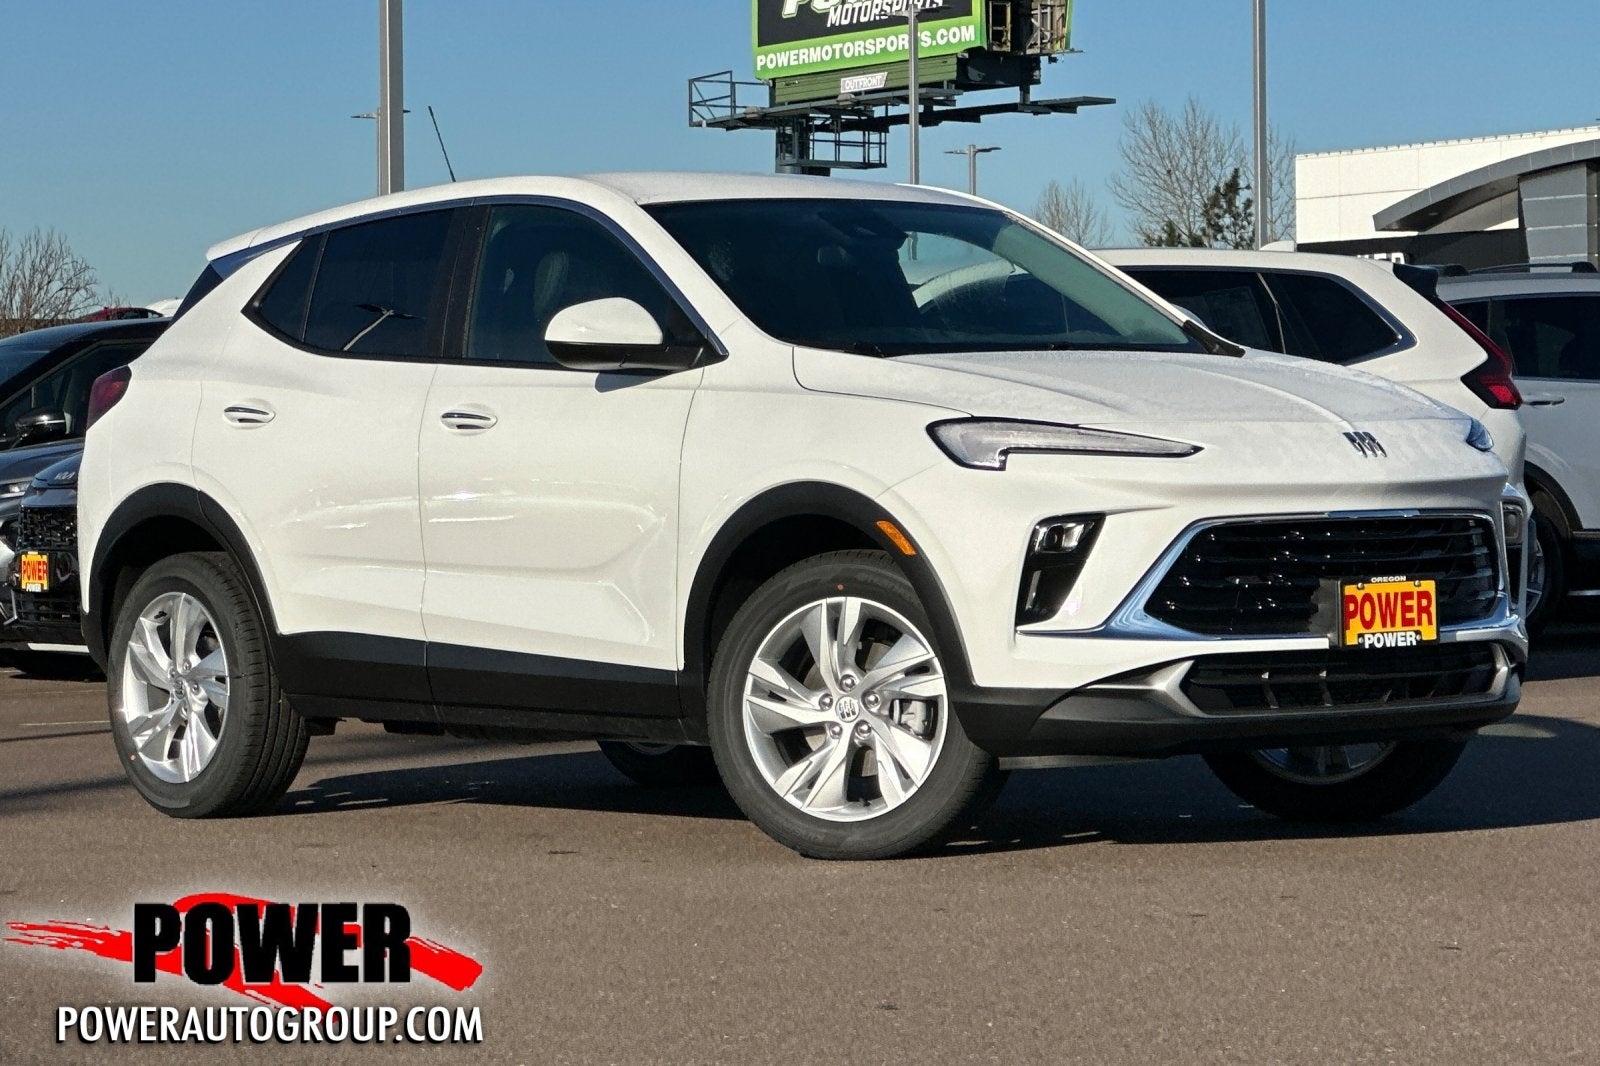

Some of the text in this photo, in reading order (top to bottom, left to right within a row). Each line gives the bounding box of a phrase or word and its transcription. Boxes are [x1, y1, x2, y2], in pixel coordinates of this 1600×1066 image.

[756, 25, 975, 71] POWERMOTORSPORS.COM
[845, 75, 882, 90] OUTFRONT
[22, 560, 48, 581] POWER
[1371, 575, 1406, 583] OREGON
[1344, 590, 1433, 631] POWER
[1364, 631, 1417, 649] POWER
